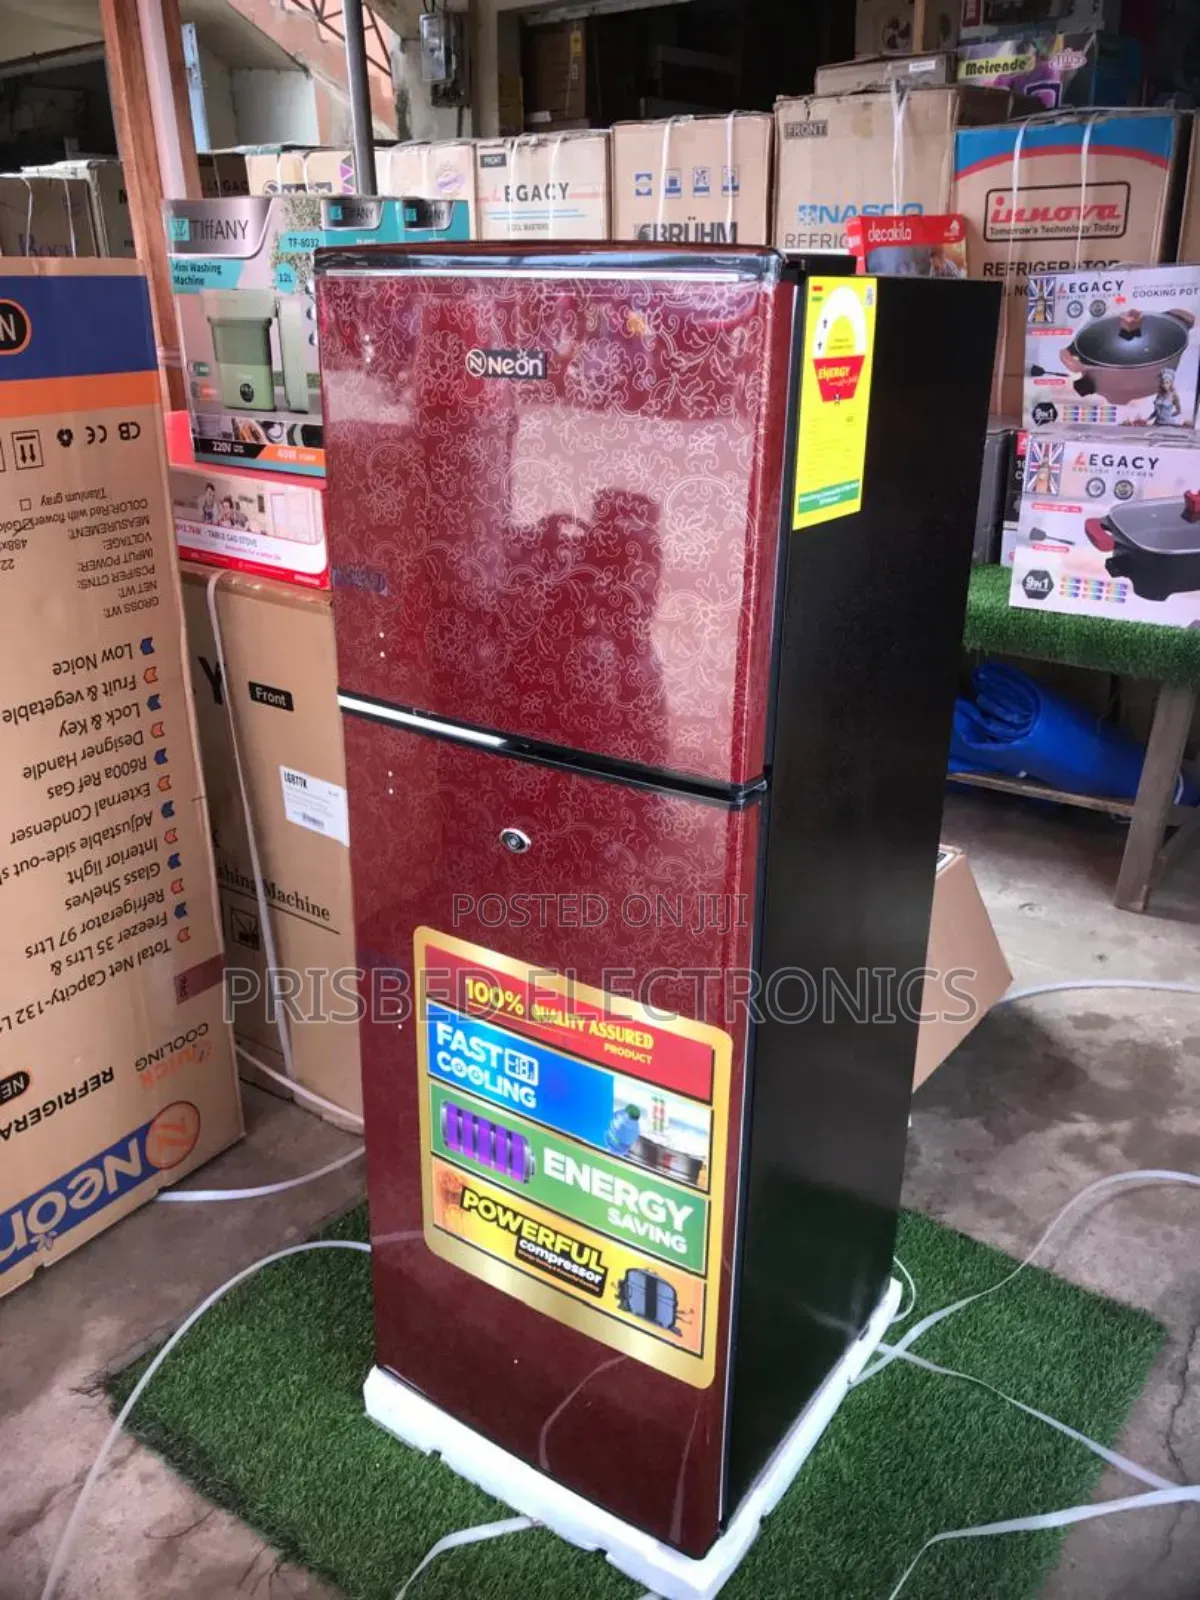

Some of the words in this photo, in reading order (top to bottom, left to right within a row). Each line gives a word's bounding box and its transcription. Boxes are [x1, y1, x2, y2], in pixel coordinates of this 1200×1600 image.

[965, 58, 1028, 77] Meirende
[785, 123, 826, 138] FRONT
[990, 195, 1122, 225] innova
[652, 215, 738, 244] BRÜHM
[867, 219, 912, 242] decakila
[1041, 224, 1091, 237] Technology
[1094, 222, 1121, 233] Today
[174, 274, 205, 286] Machine
[190, 262, 222, 277] Washing
[1057, 279, 1125, 295] LEGACY
[1132, 288, 1176, 299] COOKING
[1178, 285, 1200, 296] POT
[118, 421, 141, 441] CB
[1074, 452, 1160, 471] LEGACY
[40, 492, 63, 507] gray
[67, 507, 89, 521] with
[102, 531, 153, 551] VOLTAGE:
[77, 555, 121, 573] POWER:
[77, 574, 110, 590] CTNS:
[118, 585, 138, 598] WT:
[139, 580, 158, 594] NET
[103, 604, 122, 619] WT:
[124, 596, 159, 614] GROSS
[101, 642, 133, 663] Low
[52, 653, 98, 676] Noice
[87, 685, 99, 702] &
[102, 674, 137, 697] Fruit
[255, 686, 287, 707] Front
[2, 690, 85, 726] vegetable
[105, 702, 141, 727] Lock
[59, 718, 89, 738] Key
[91, 714, 102, 731] &
[80, 730, 145, 762] Designer
[23, 751, 78, 782] Handle
[104, 755, 148, 779] R600a
[46, 781, 75, 800] Gas
[78, 771, 102, 790] Ref
[95, 781, 151, 817] External
[9, 804, 91, 846] Condenser
[80, 811, 154, 847] Adjustable
[13, 841, 77, 878] side-out
[105, 837, 158, 868] Interior
[67, 861, 103, 886] light
[124, 862, 162, 886] Glass
[64, 879, 121, 911] Shelves
[263, 877, 331, 922] Machine
[79, 888, 166, 936] Refrigerator
[58, 926, 78, 948] 97
[117, 911, 169, 944] Freezer
[24, 936, 56, 960] Ltrs
[66, 945, 95, 968] Ltrs
[96, 935, 115, 956] 35
[138, 938, 173, 966] Total
[50, 959, 62, 977] &
[108, 955, 135, 977] Net
[15, 969, 107, 1026] Capcity-132
[465, 977, 524, 1017] 100%
[531, 1003, 585, 1032] QUALITY
[589, 1021, 655, 1050] ASSURED
[135, 1022, 209, 1072] COOLING
[436, 1020, 503, 1068] FAST
[603, 1042, 653, 1065] PRODUCT
[436, 1050, 537, 1109] COOLING
[543, 1146, 694, 1232] ENERGY
[462, 1188, 607, 1274] POWERFUL
[607, 1207, 688, 1255] SAVING
[519, 1239, 602, 1284] compressor
